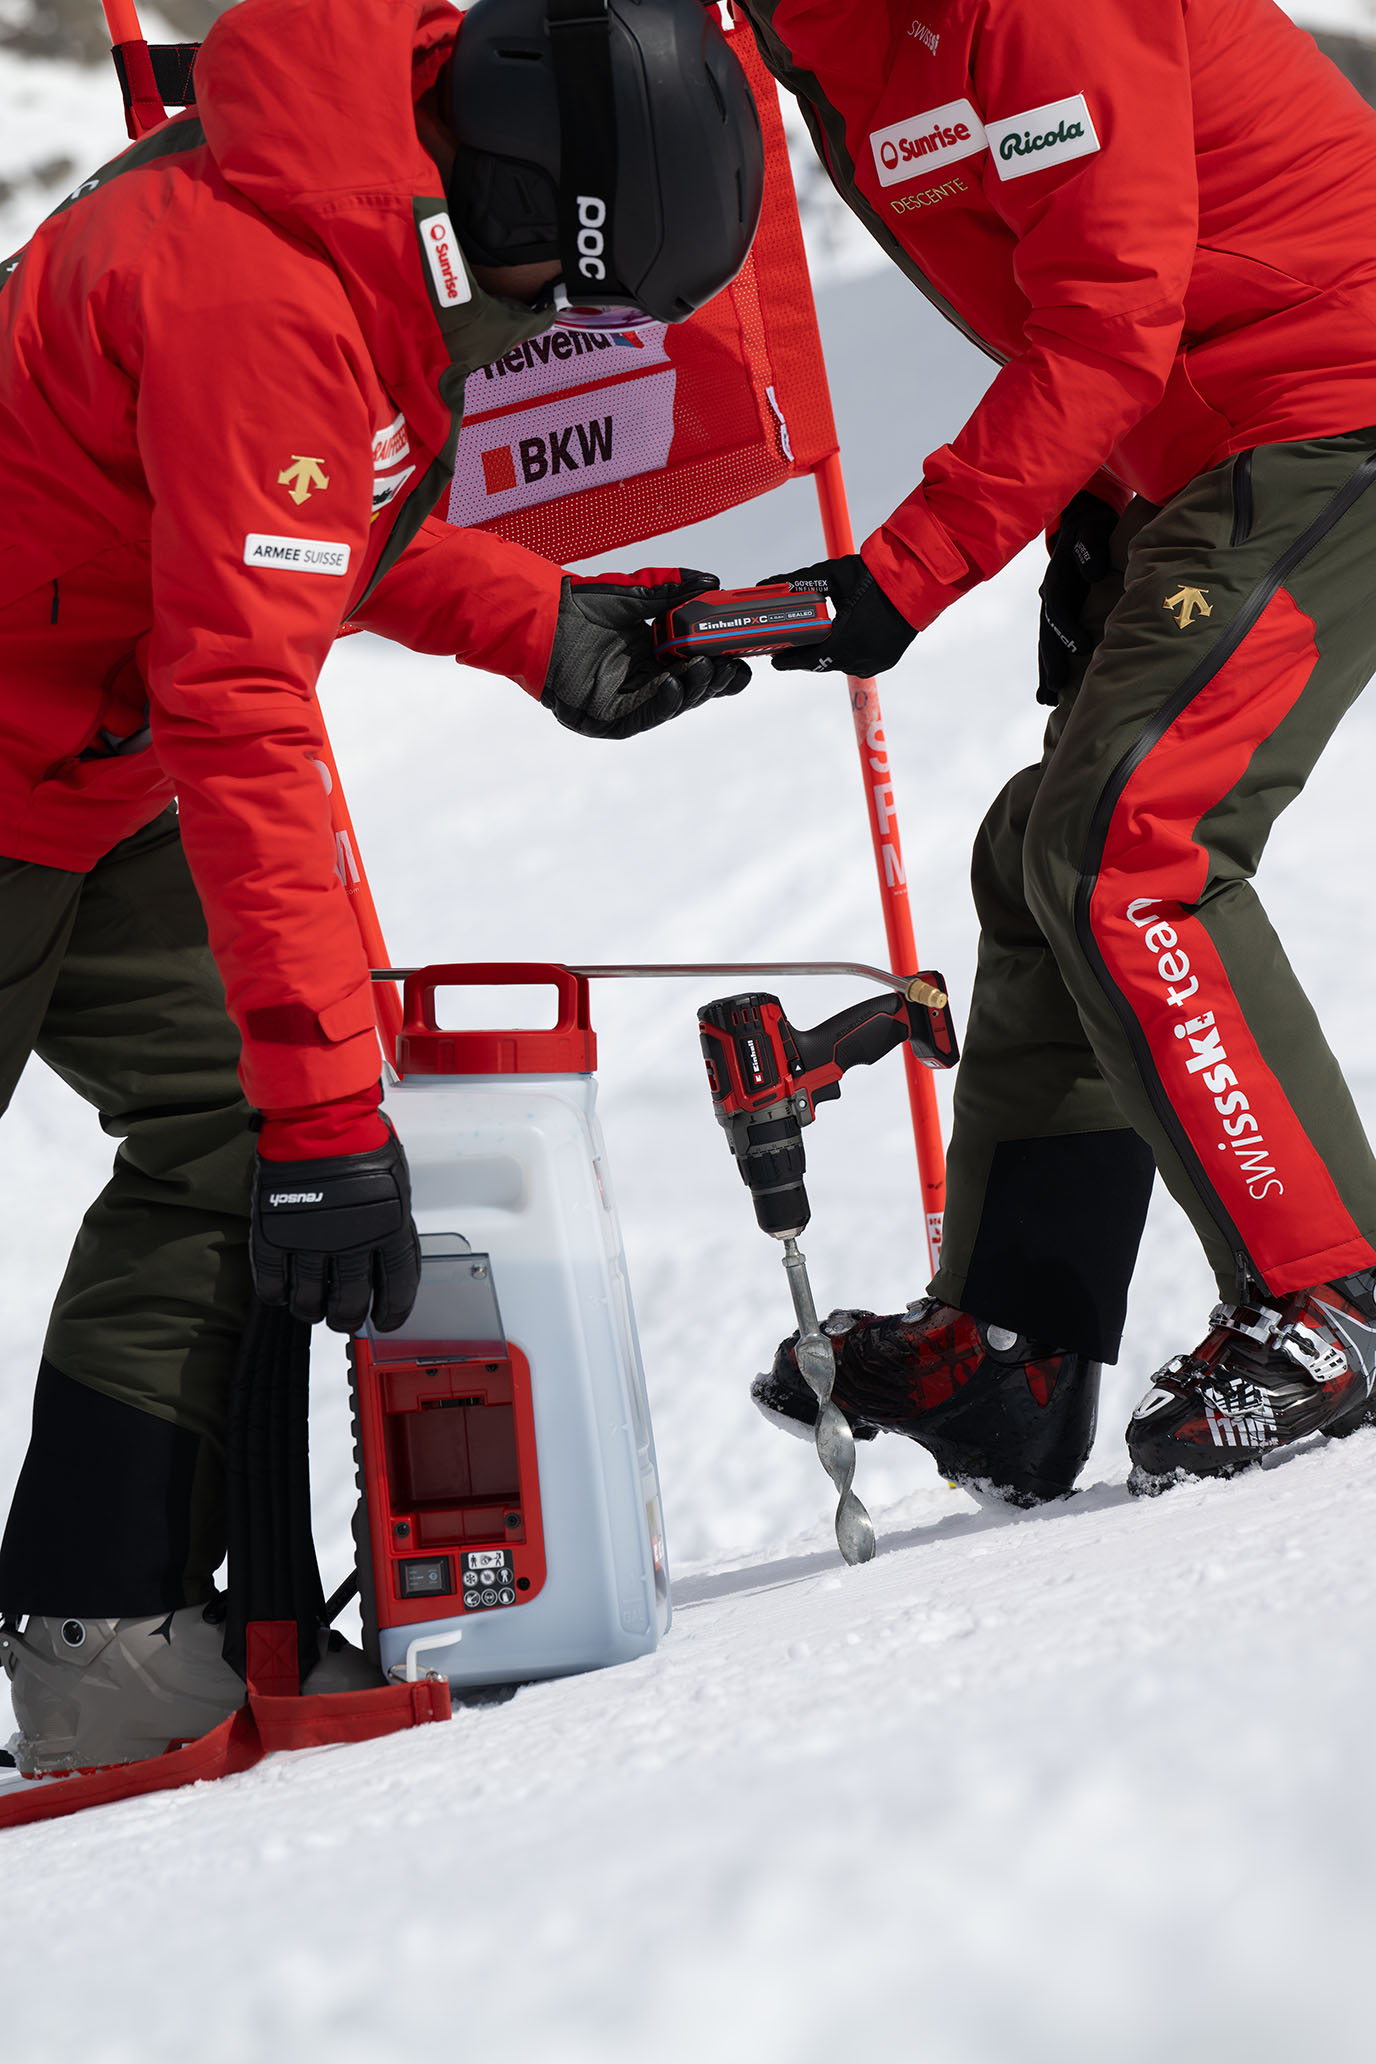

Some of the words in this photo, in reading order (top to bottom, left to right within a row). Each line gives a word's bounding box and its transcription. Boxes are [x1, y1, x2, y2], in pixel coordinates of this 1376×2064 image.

[899, 123, 971, 161] Sunrise
[999, 120, 1084, 160] Ricola
[890, 178, 968, 214] DESCENTE
[435, 243, 459, 299] Sunrise
[518, 415, 613, 484] BKW
[253, 545, 301, 561] ARMEE
[303, 550, 344, 567] SUISSE
[698, 618, 743, 631] Einhell
[744, 614, 768, 627] PXC
[787, 610, 813, 618] SEALED
[747, 1039, 760, 1072] Einhell
[269, 1192, 324, 1207] reusch
